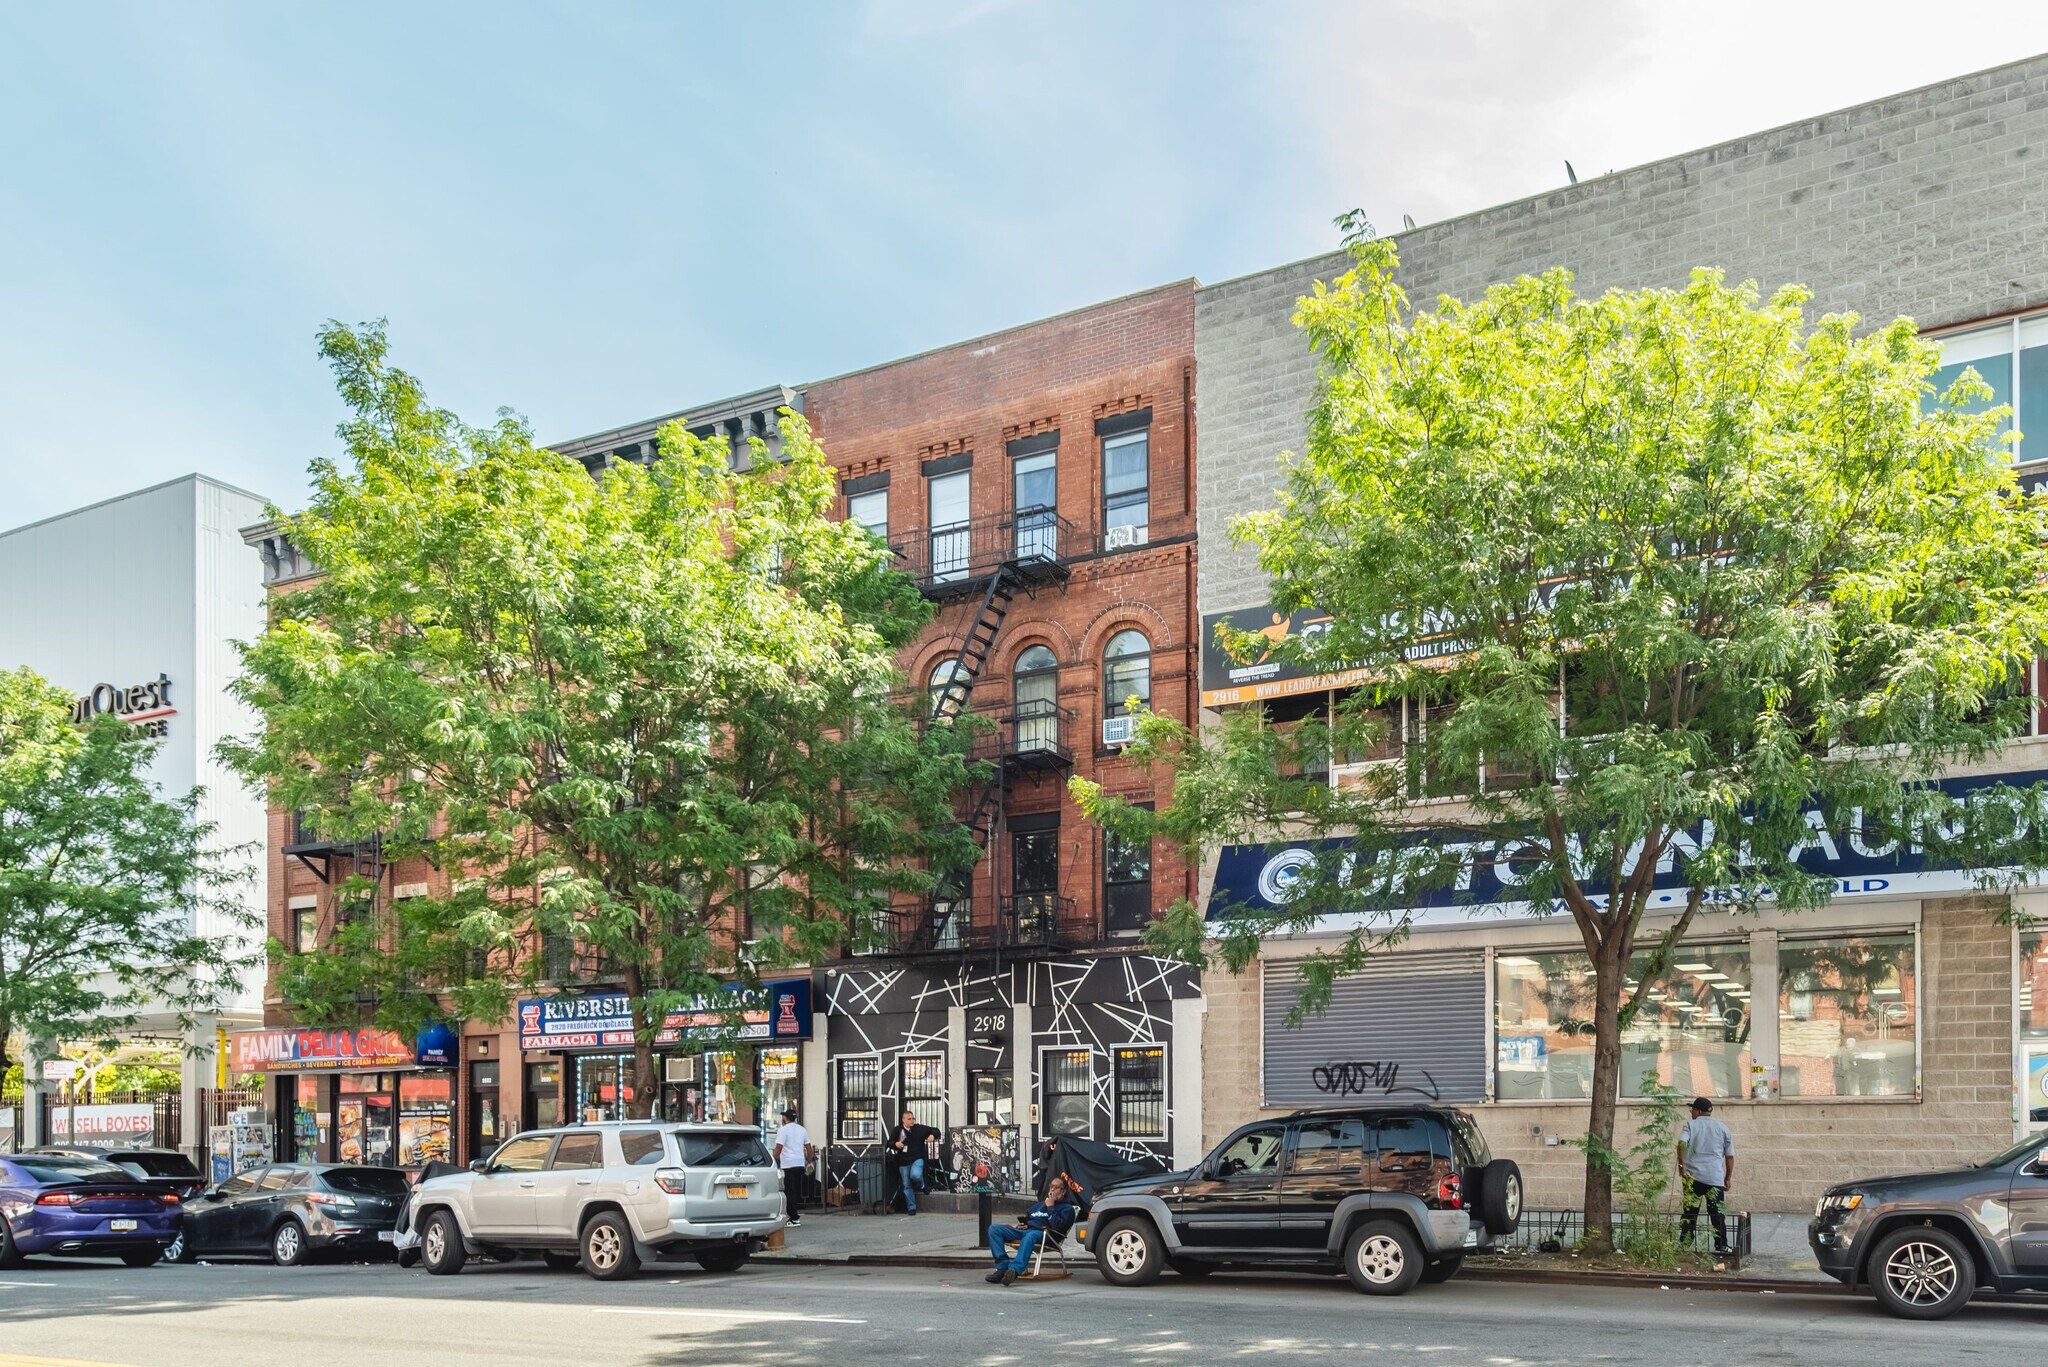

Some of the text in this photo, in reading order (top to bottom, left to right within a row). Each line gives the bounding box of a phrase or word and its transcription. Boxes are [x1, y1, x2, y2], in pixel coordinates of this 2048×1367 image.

[1404, 642, 1439, 660] ADULT
[1213, 690, 1240, 703] 2916
[567, 1021, 598, 1030] FREDERICK
[599, 1020, 630, 1029] DOUGLASS
[973, 1014, 1006, 1032] 2918
[240, 1033, 297, 1063] FAMILY
[298, 1030, 338, 1058] DELI
[339, 1030, 354, 1057] &
[524, 1034, 595, 1048] FARMACIA
[267, 1062, 302, 1070] SANDWICHES
[306, 1060, 337, 1069] BEVERAGES
[352, 1058, 371, 1066] CREAM
[76, 1117, 103, 1134] SELL
[106, 1115, 152, 1133] BOXES!
